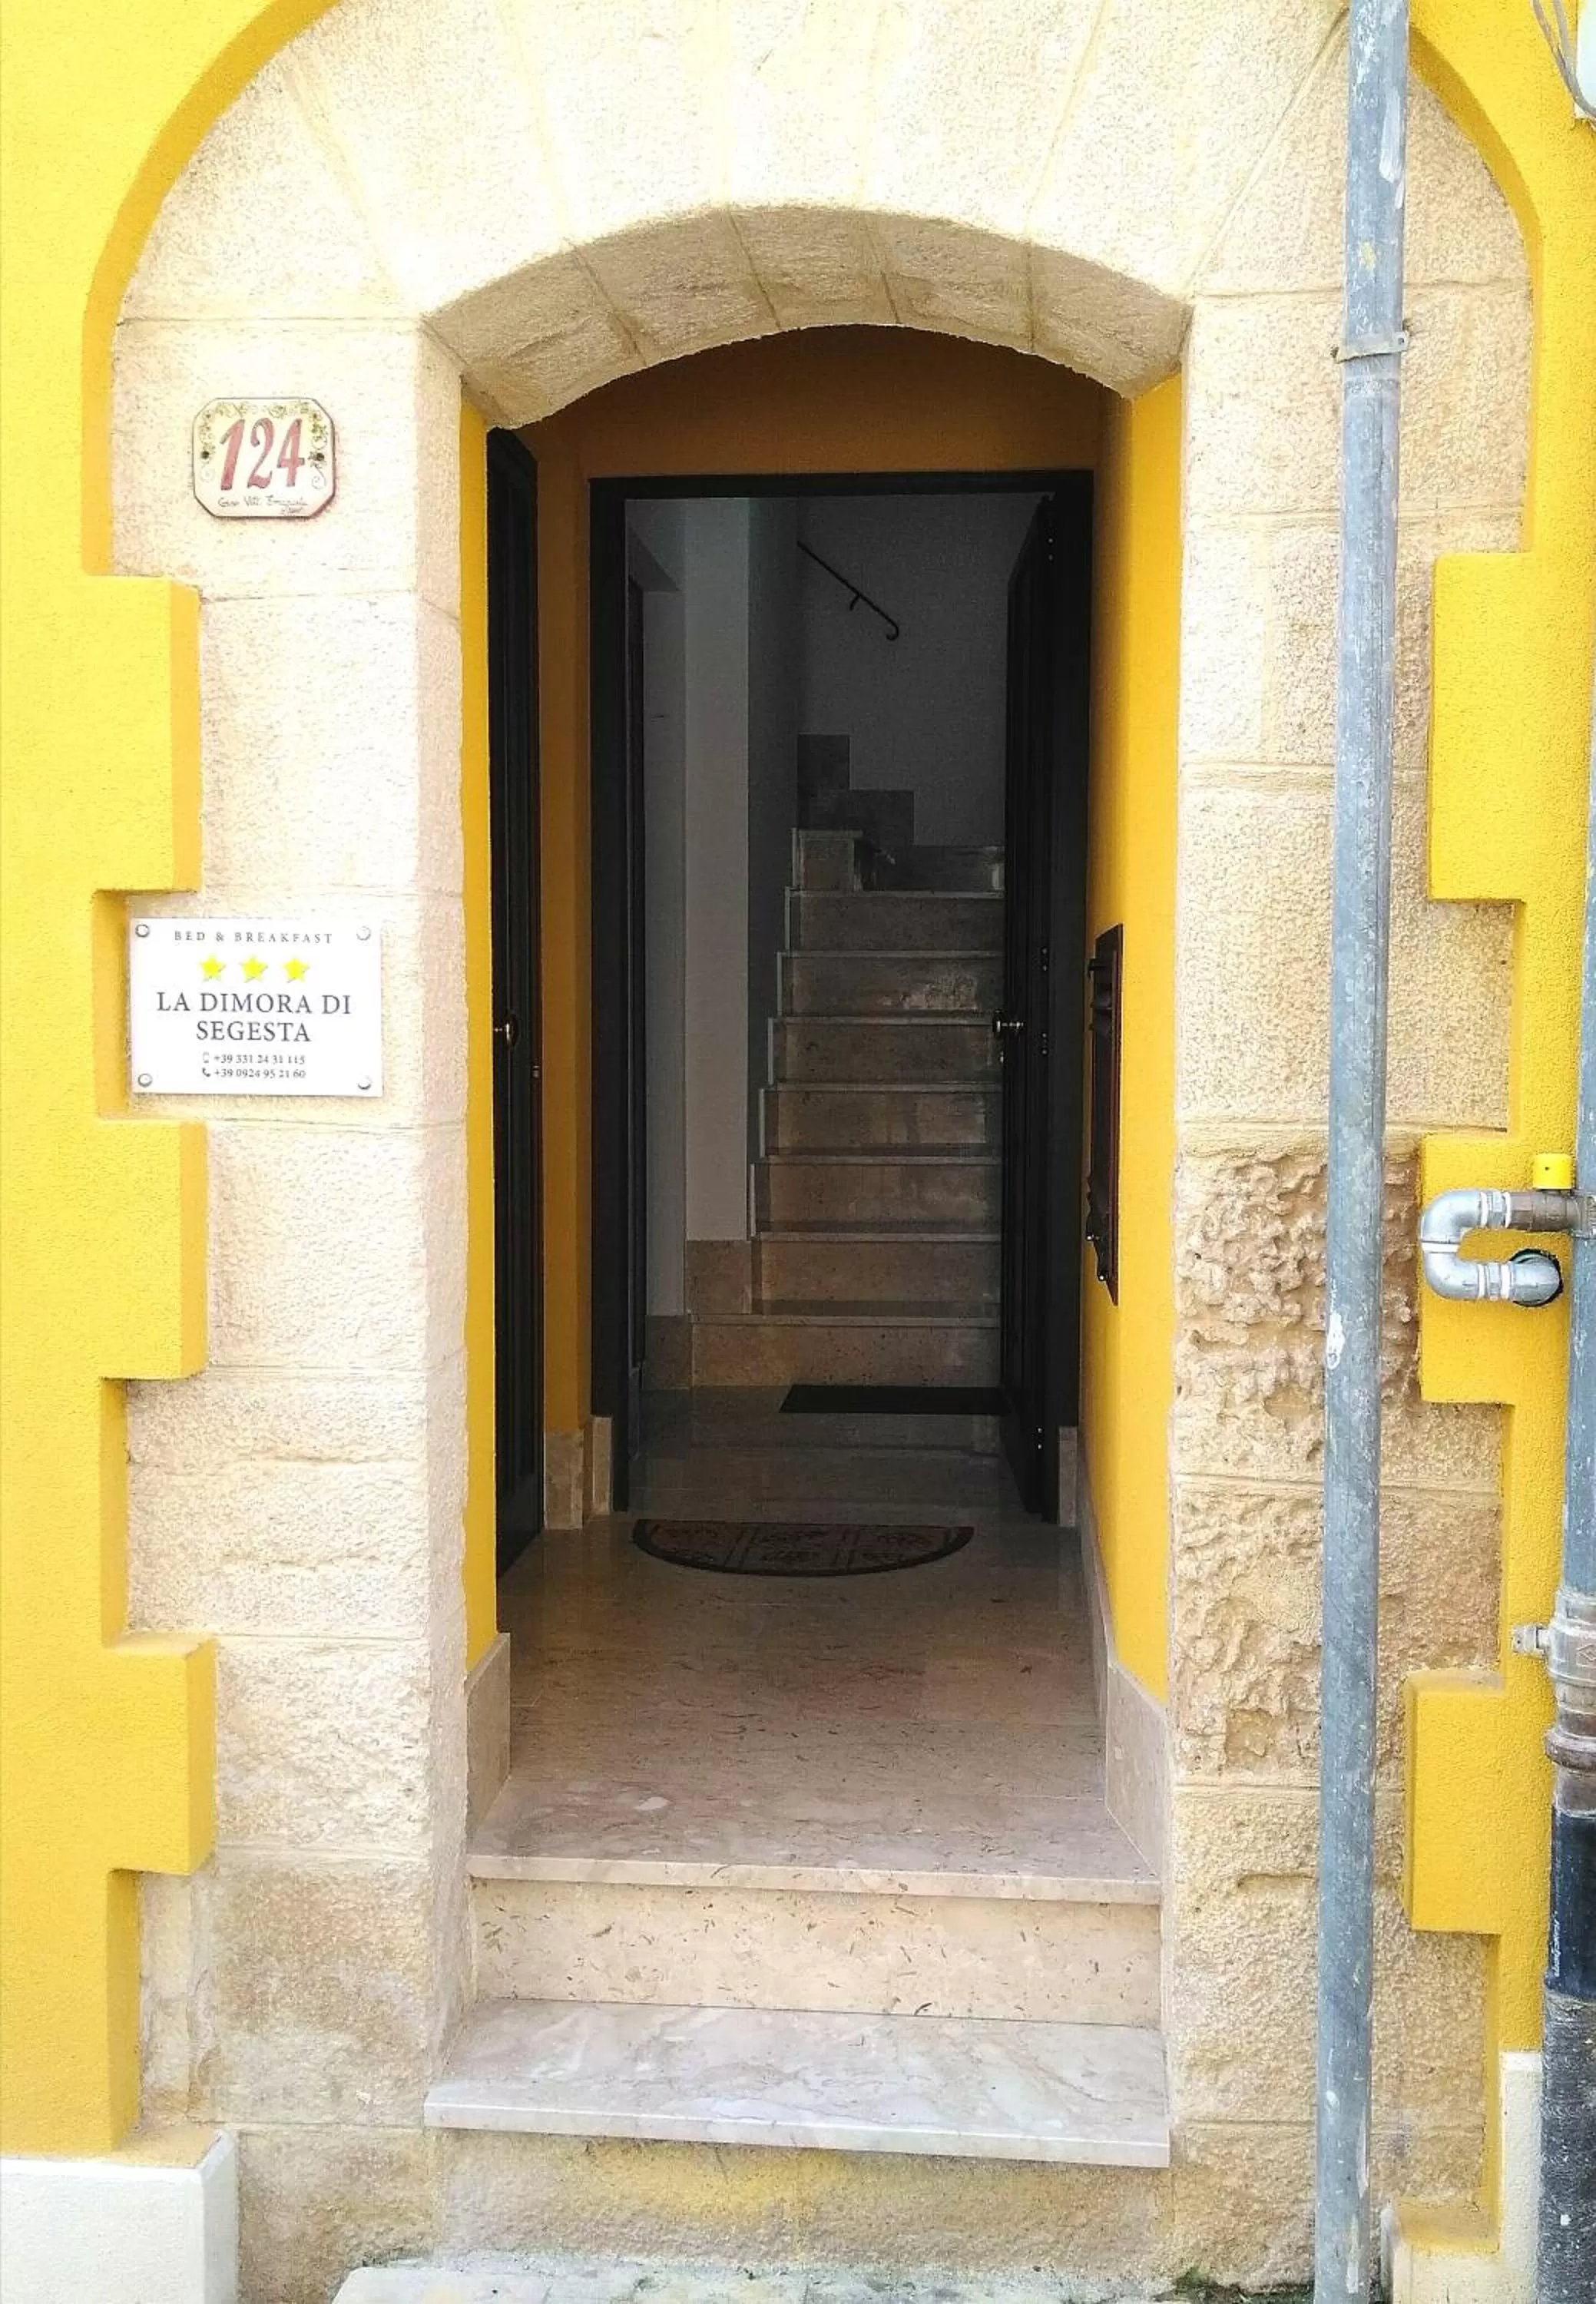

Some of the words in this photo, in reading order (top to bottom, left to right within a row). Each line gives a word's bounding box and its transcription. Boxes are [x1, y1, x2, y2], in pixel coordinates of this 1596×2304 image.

[220, 417, 305, 491] 124
[174, 931, 205, 942] BED
[216, 932, 225, 942] &
[234, 932, 333, 944] BREAKFAST
[157, 991, 190, 1011] LA
[200, 993, 313, 1014] DIMORA
[322, 995, 351, 1015] DI
[196, 1020, 311, 1042] SEGESTA
[214, 1054, 233, 1064] +39
[214, 1068, 233, 1078] +39
[263, 1069, 276, 1079] 95
